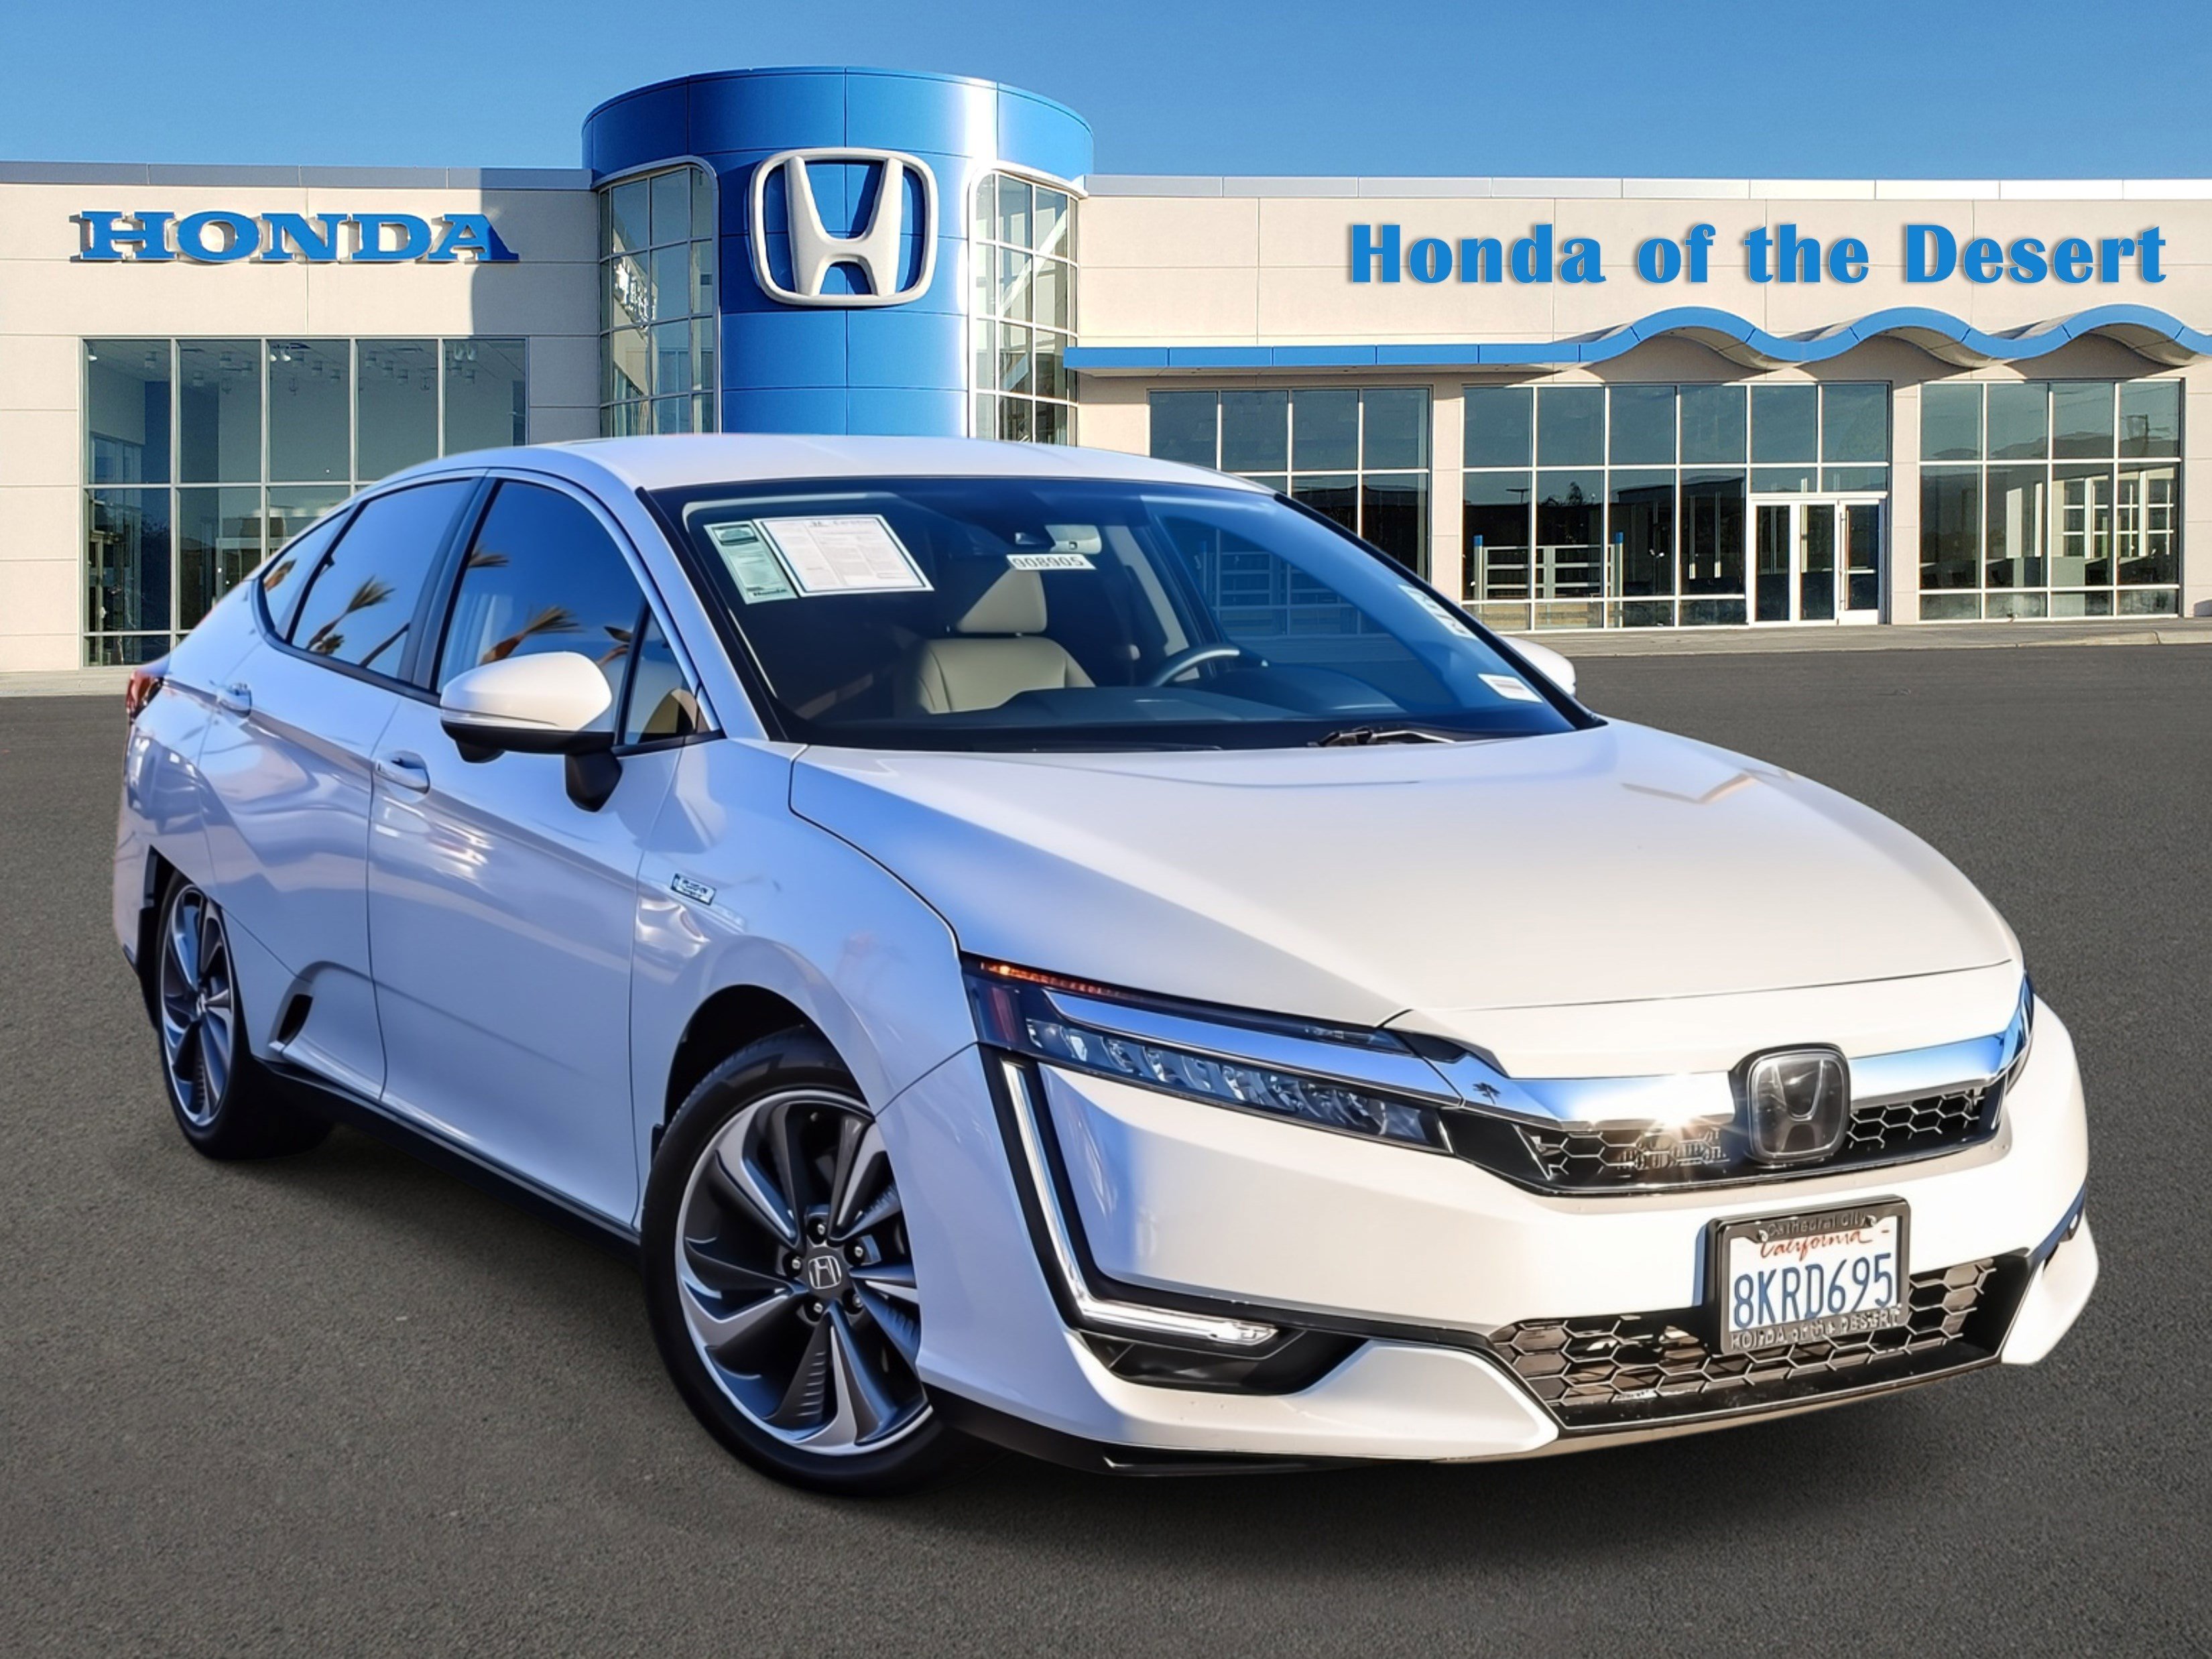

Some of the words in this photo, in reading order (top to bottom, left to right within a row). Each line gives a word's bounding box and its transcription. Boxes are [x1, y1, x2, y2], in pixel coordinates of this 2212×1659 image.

[78, 211, 519, 262] HONDA
[1353, 224, 1606, 284] Honda
[1638, 224, 1716, 284] of
[1744, 224, 1868, 284] the
[1907, 225, 2166, 284] Desert
[1760, 1229, 1873, 1262] California
[1733, 1252, 1893, 1329] 8KRD695
